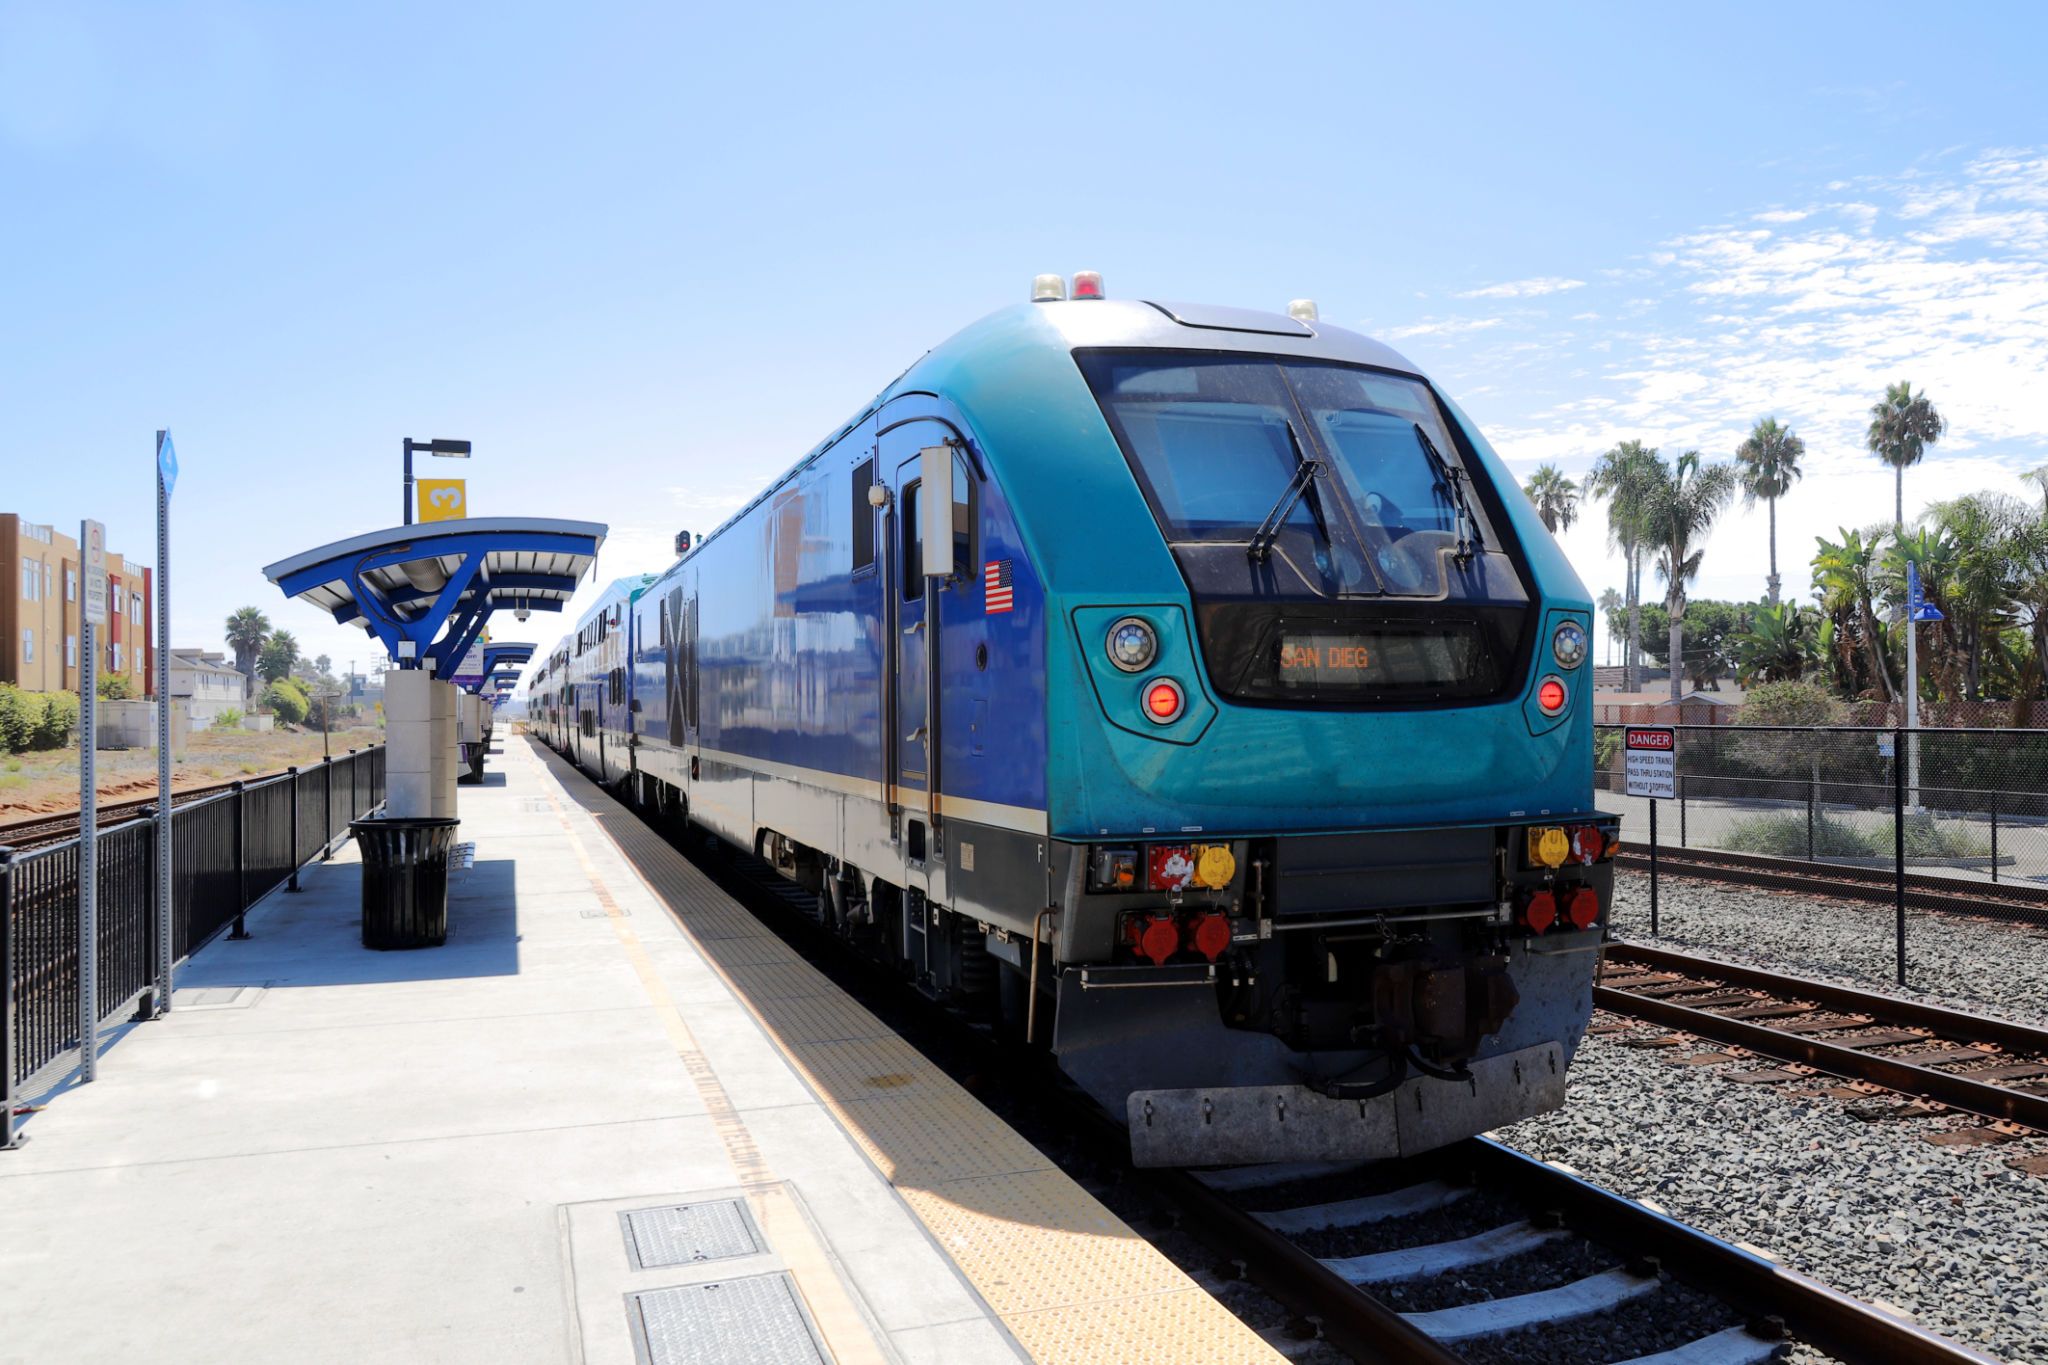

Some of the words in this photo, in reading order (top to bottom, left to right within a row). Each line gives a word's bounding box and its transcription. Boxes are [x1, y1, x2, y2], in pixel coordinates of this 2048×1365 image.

[429, 486, 462, 509] 3
[1280, 646, 1321, 669] SAN
[1630, 734, 1669, 745] DANGER
[1628, 755, 1638, 763] HIGH
[1640, 755, 1655, 765] SPEED
[1655, 756, 1673, 766] TRAINS
[1627, 768, 1639, 777] PASS
[1640, 768, 1653, 778] THRU
[1653, 769, 1673, 779] STATION
[1629, 782, 1648, 790] WITHOUT
[1649, 782, 1672, 792] STOPPING
[1037, 843, 1043, 863] F
